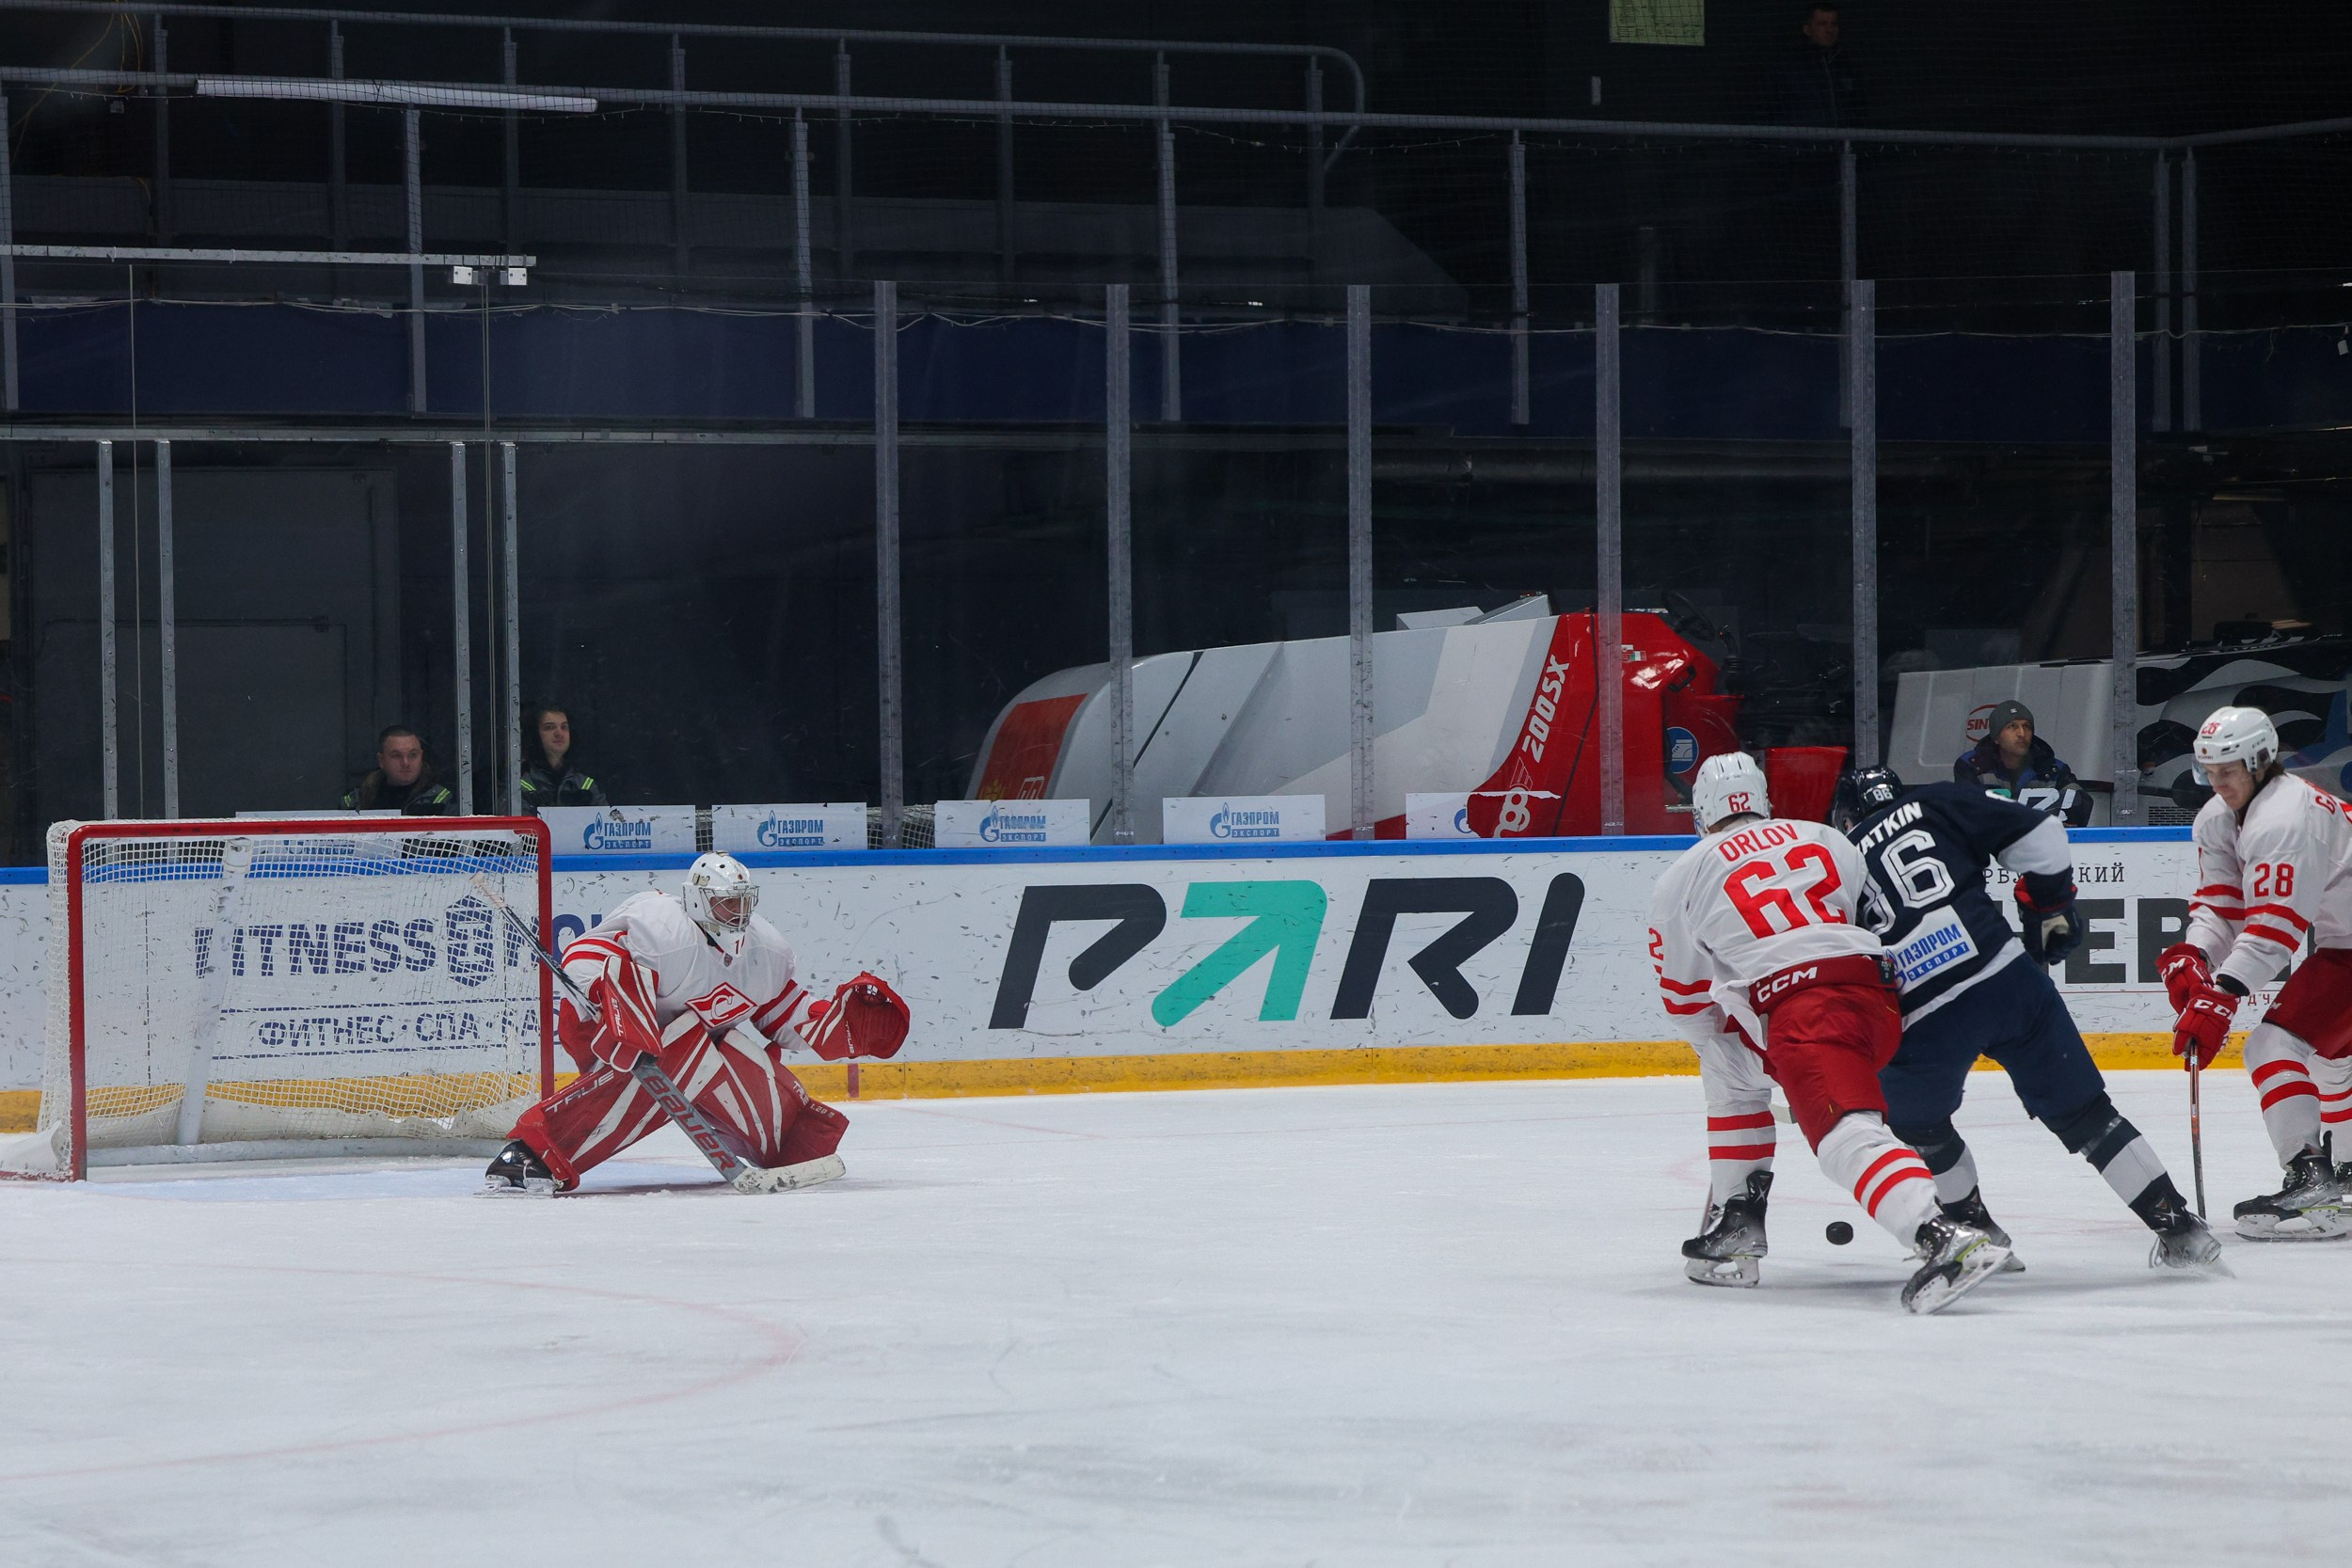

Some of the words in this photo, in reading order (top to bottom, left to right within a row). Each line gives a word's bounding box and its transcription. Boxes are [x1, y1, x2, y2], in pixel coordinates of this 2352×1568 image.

[1522, 655, 1570, 764] 200SX
[1728, 792, 1752, 813] 62
[1872, 787, 1894, 801] 86
[604, 821, 651, 836] ГАЗПРОМ
[777, 819, 823, 834] ГАЗПРОМ
[1232, 812, 1279, 826] ГАЗПРОМ
[1232, 829, 1279, 837] ЭКСПОРТ
[1856, 801, 1923, 856] ATKIN
[605, 840, 651, 848] ЭКСПОРТ
[778, 837, 823, 846] ЭКСПОРТ
[1002, 833, 1045, 842] ЭКСПОРТ
[1719, 823, 1799, 862] ORLOV
[1724, 843, 1848, 939] 62
[2254, 863, 2294, 898] 28
[1898, 924, 1963, 969] ГАЗПРОМ
[1909, 942, 1969, 980] ЭКСПОРТ
[1756, 966, 1819, 1004] CCM
[611, 997, 624, 1037] TRUE
[544, 1069, 614, 1114] TRUE
[792, 1080, 810, 1106] TRUE
